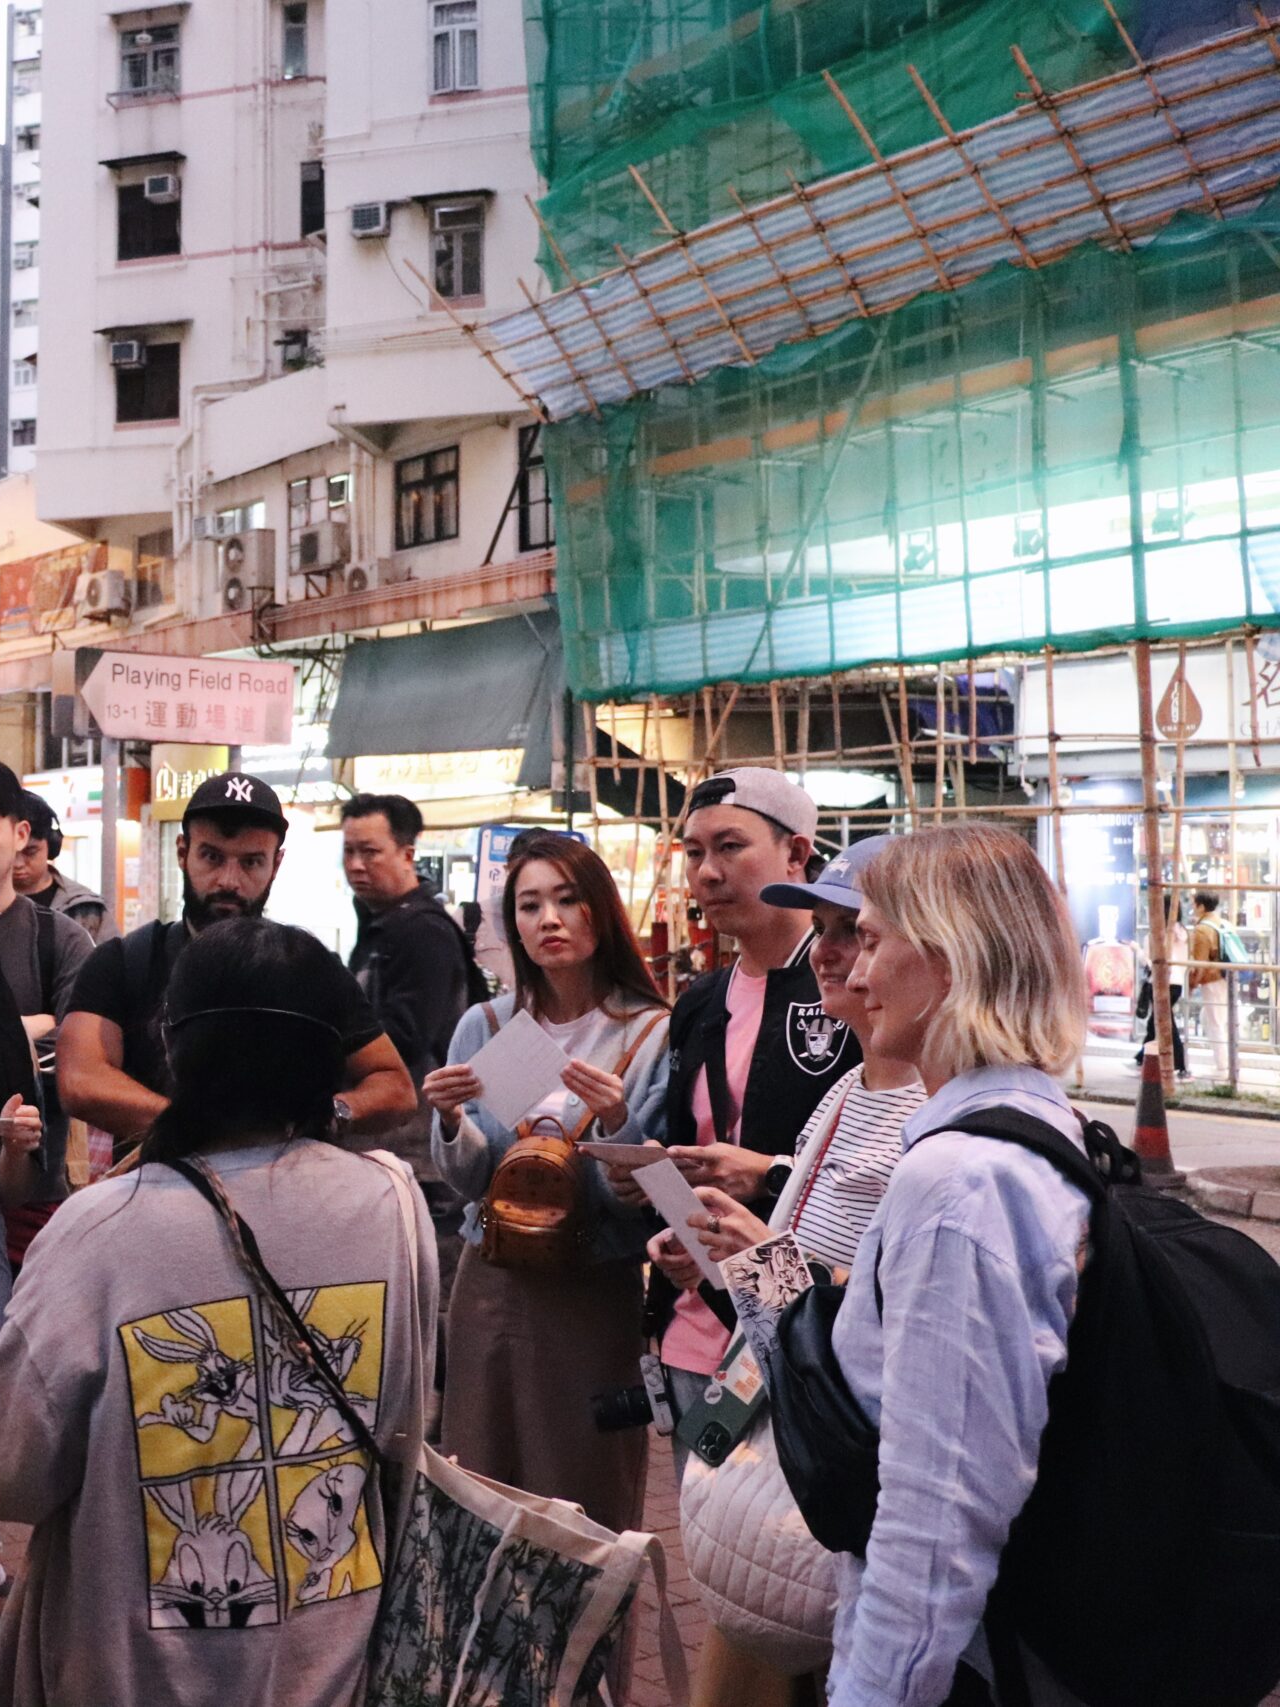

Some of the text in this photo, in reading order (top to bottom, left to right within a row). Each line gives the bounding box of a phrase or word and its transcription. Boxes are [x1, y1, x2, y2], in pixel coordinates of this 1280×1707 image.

[111, 663, 288, 695] Playing Field Road
[106, 700, 256, 733] 13-1 運動場道
[225, 777, 254, 802] NY
